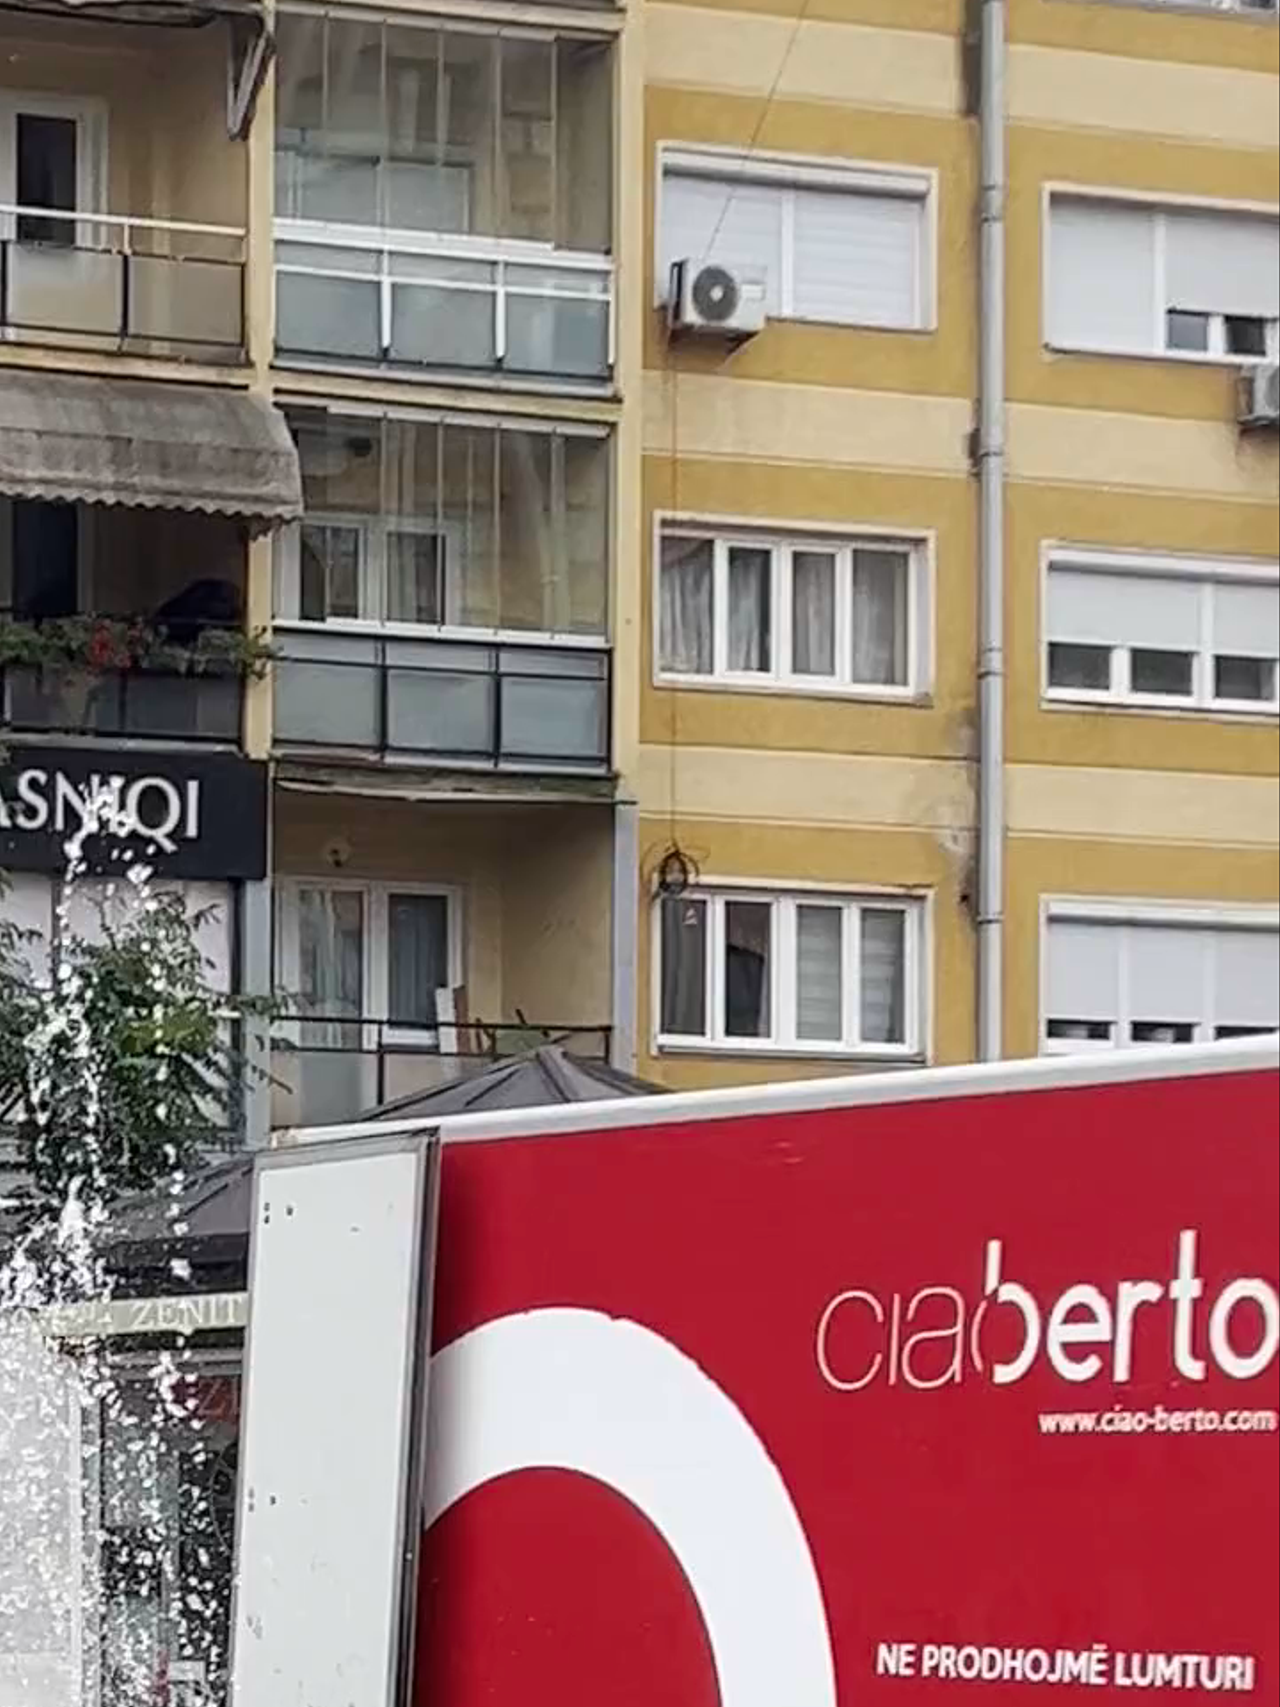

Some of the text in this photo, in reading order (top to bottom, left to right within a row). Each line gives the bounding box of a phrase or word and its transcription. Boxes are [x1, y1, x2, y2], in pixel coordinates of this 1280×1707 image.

[1038, 1405, 1278, 1435] www.ciao-berto.com
[876, 1642, 917, 1677] NE
[1113, 1651, 1255, 1691] LUMTURI
